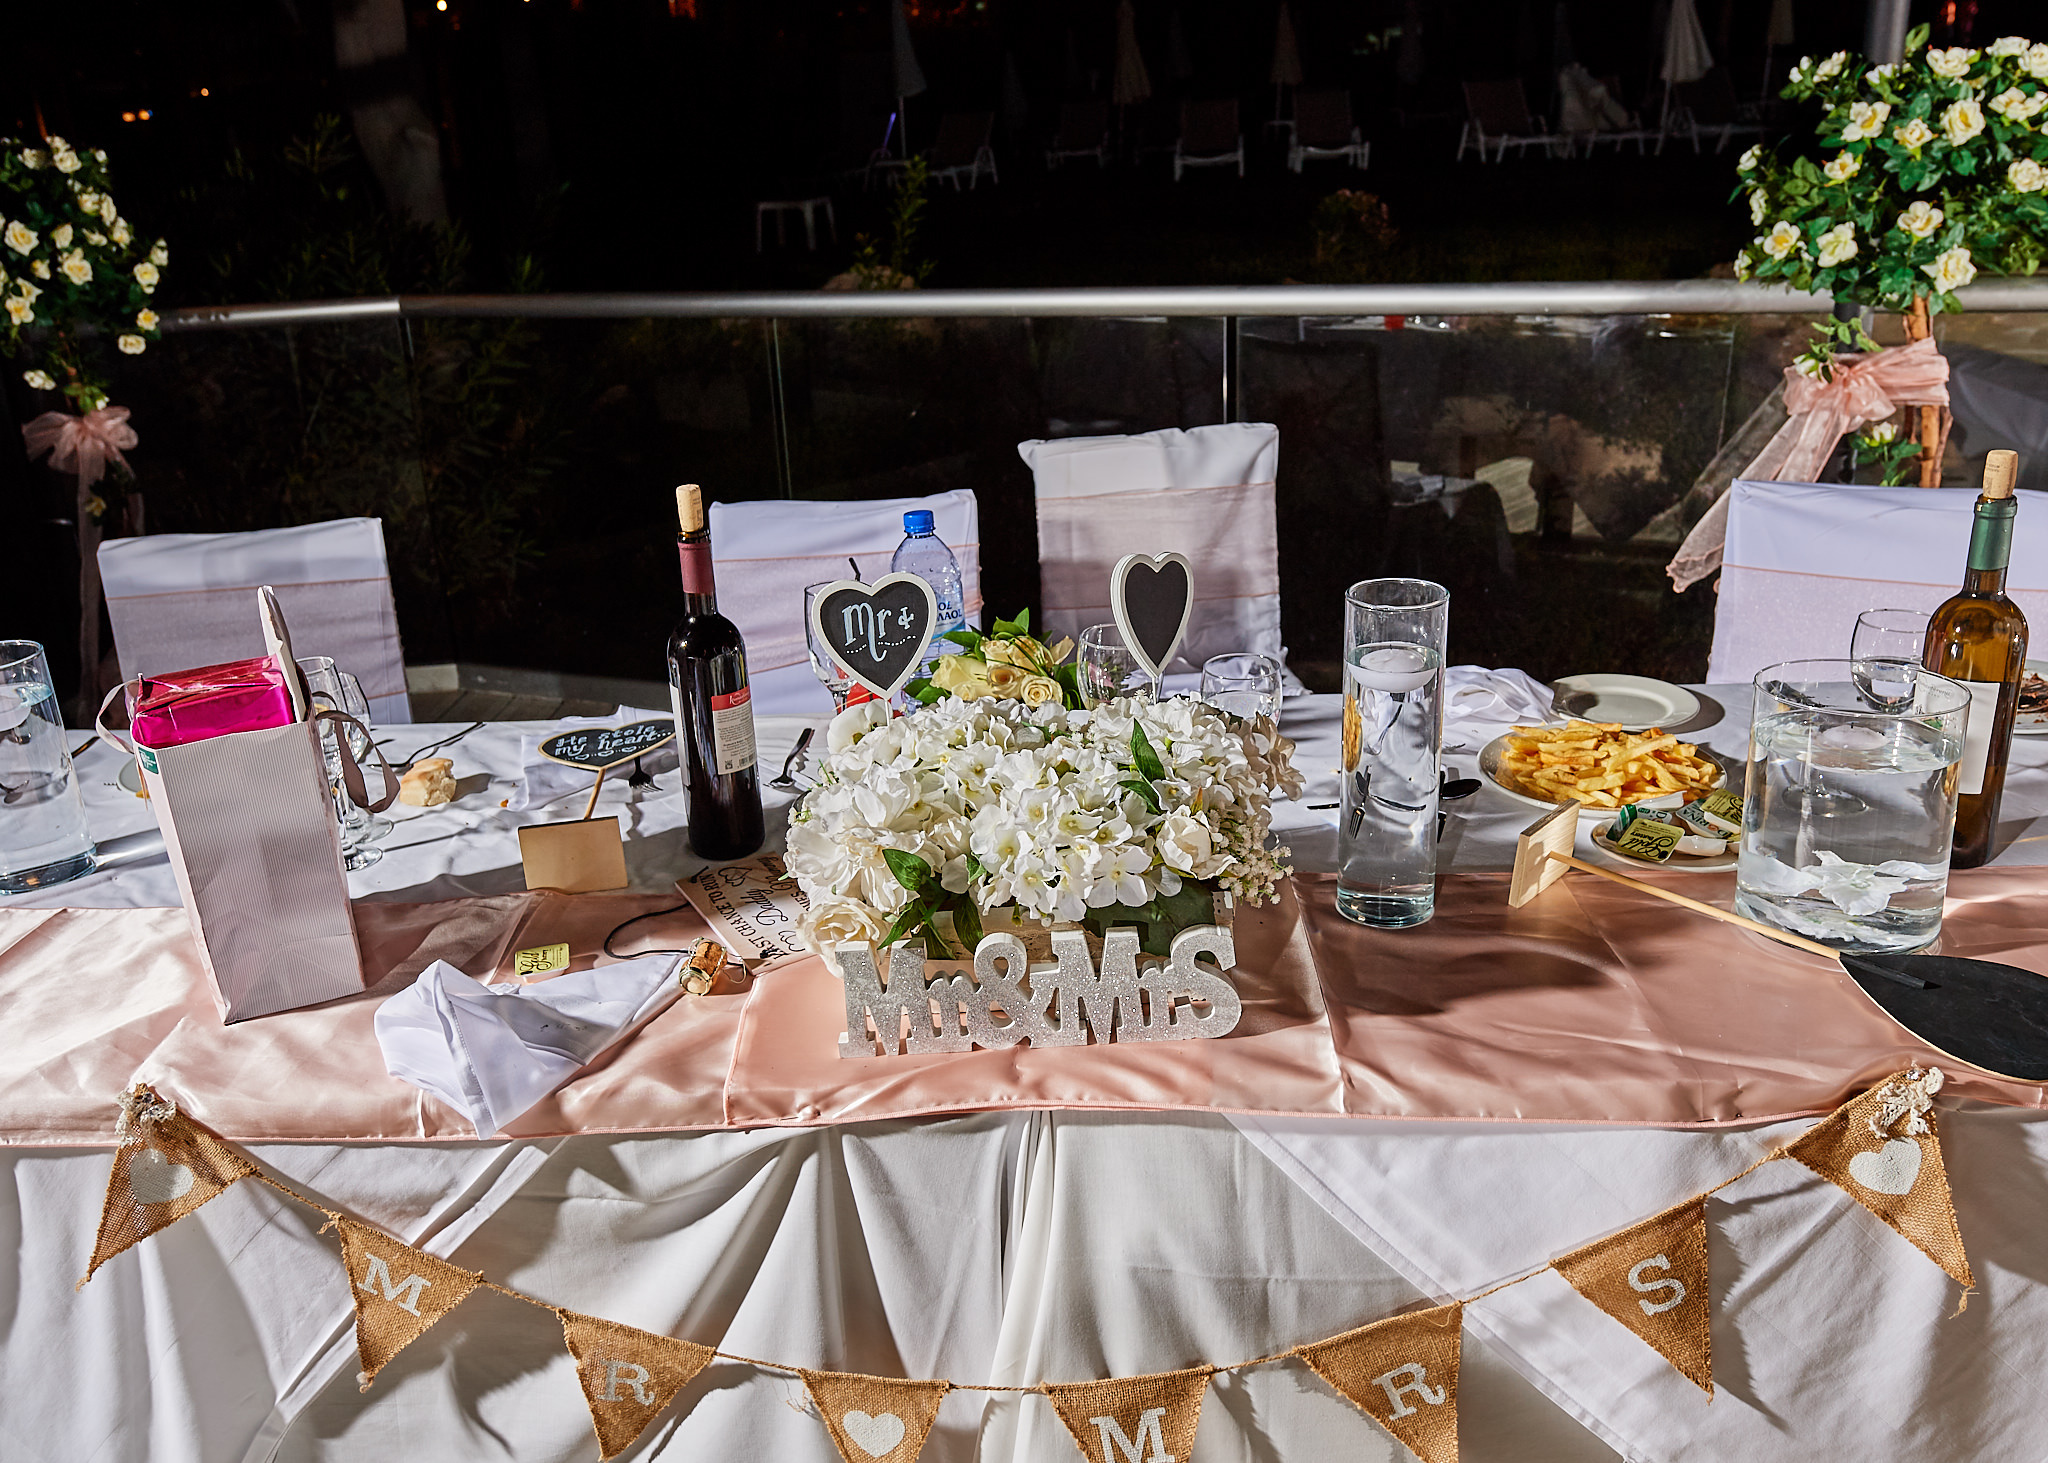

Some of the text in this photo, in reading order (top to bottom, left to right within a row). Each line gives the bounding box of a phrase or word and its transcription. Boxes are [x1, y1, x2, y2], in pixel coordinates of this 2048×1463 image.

[841, 602, 892, 663] Mr
[554, 743, 588, 757] my
[700, 873, 720, 892] RUN
[708, 890, 726, 904] TO
[715, 902, 757, 937] CHANCE
[740, 888, 789, 926] Daddy
[356, 1252, 655, 1406] M R
[1089, 1253, 1686, 1463] M R S
